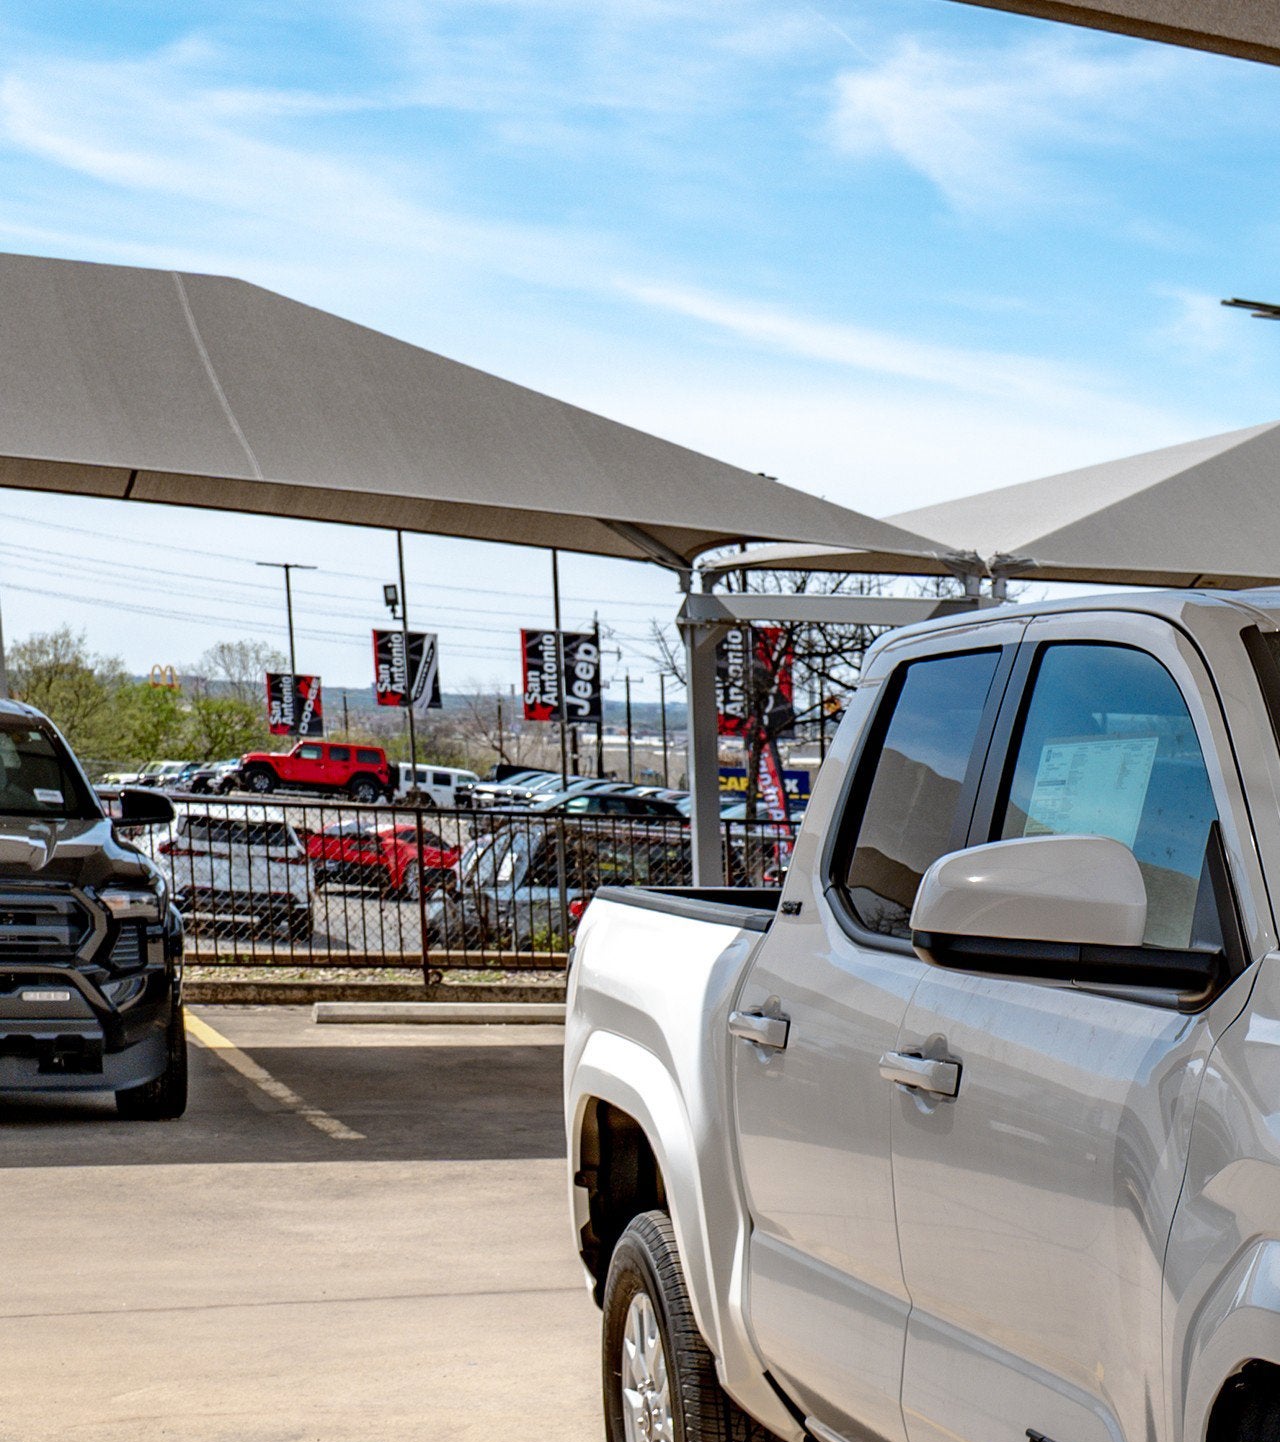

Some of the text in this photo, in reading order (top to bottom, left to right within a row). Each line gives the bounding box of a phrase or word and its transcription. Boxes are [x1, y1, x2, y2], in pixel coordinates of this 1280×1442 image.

[377, 664, 392, 693] San
[388, 633, 405, 694] Antonio
[525, 670, 541, 705] San
[539, 634, 558, 706] Antonio
[566, 642, 599, 716] Jeep
[269, 701, 281, 725] San
[279, 676, 294, 725] Antonio
[299, 677, 320, 735] DODGE
